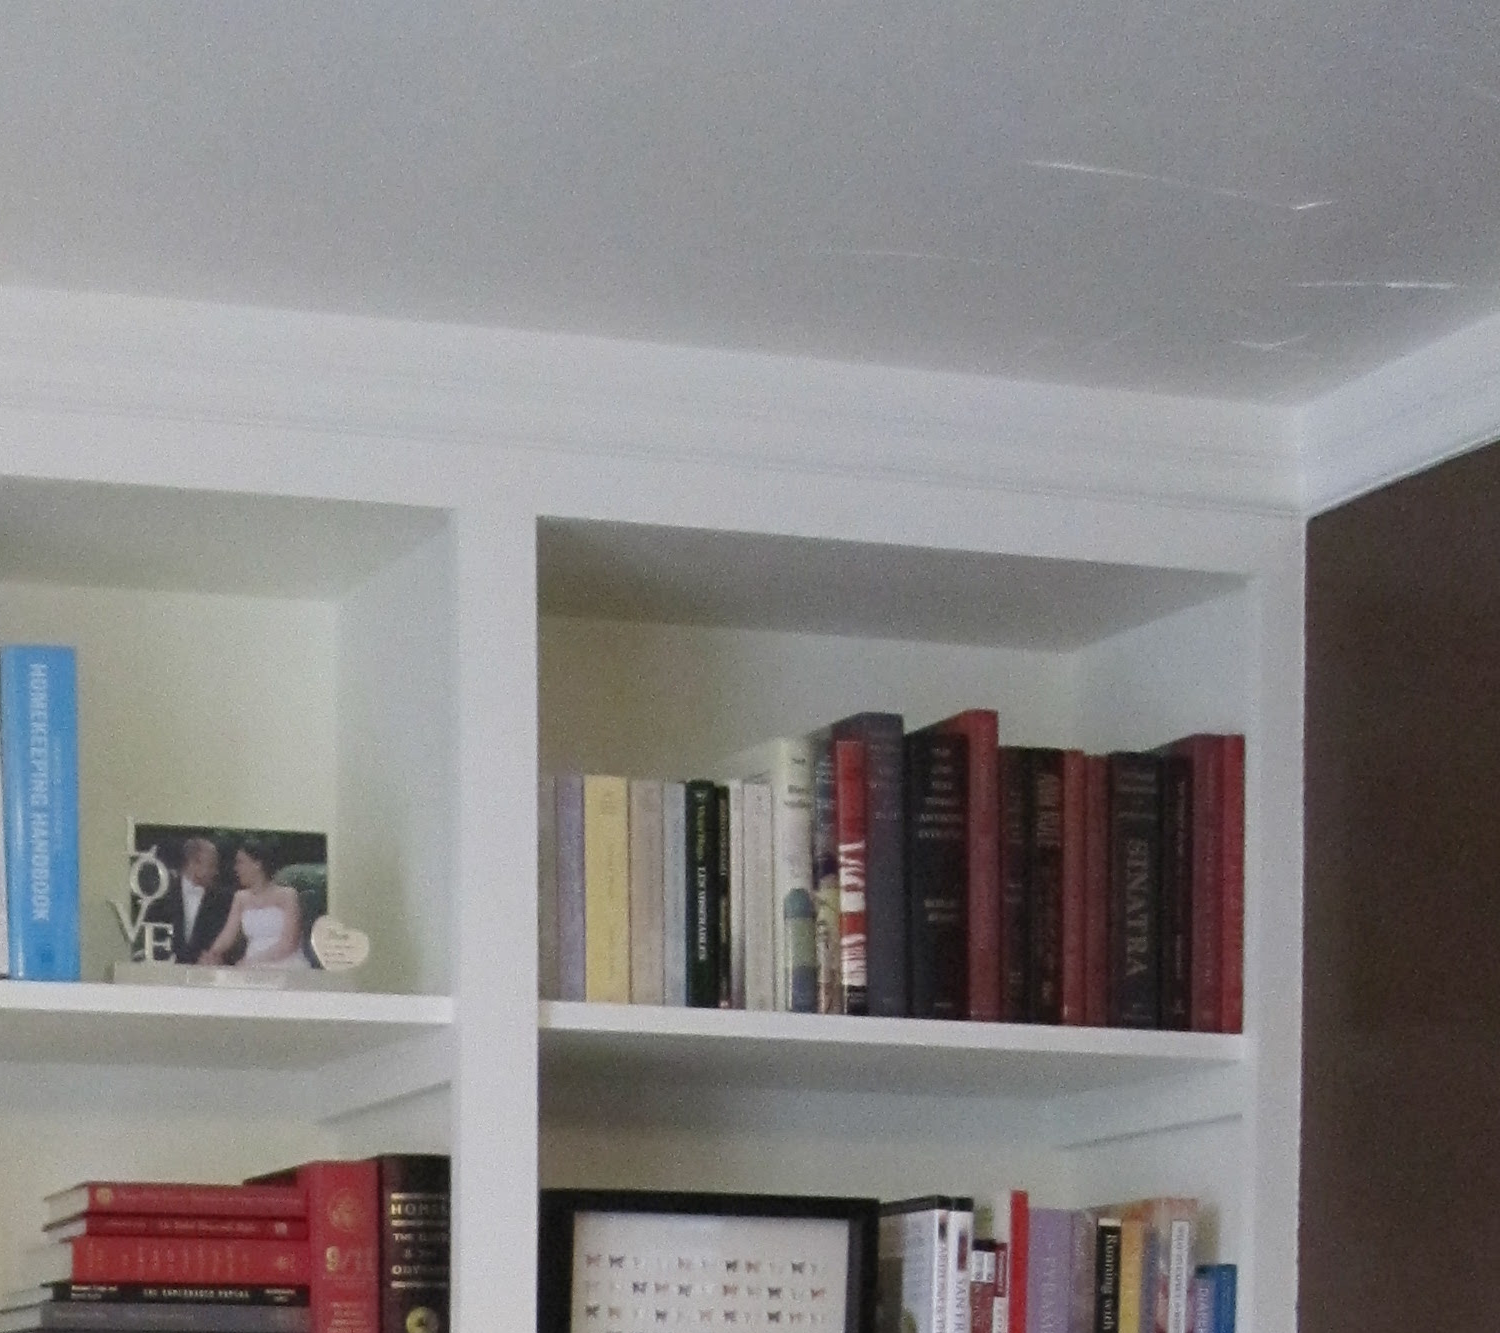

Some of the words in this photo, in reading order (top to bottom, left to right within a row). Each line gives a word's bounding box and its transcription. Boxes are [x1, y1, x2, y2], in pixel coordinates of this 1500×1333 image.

[1125, 838, 1149, 976] SINATRA
[1104, 1233, 1117, 1294] Running
[956, 1279, 967, 1308] SAN
[1103, 1299, 1115, 1331] with
